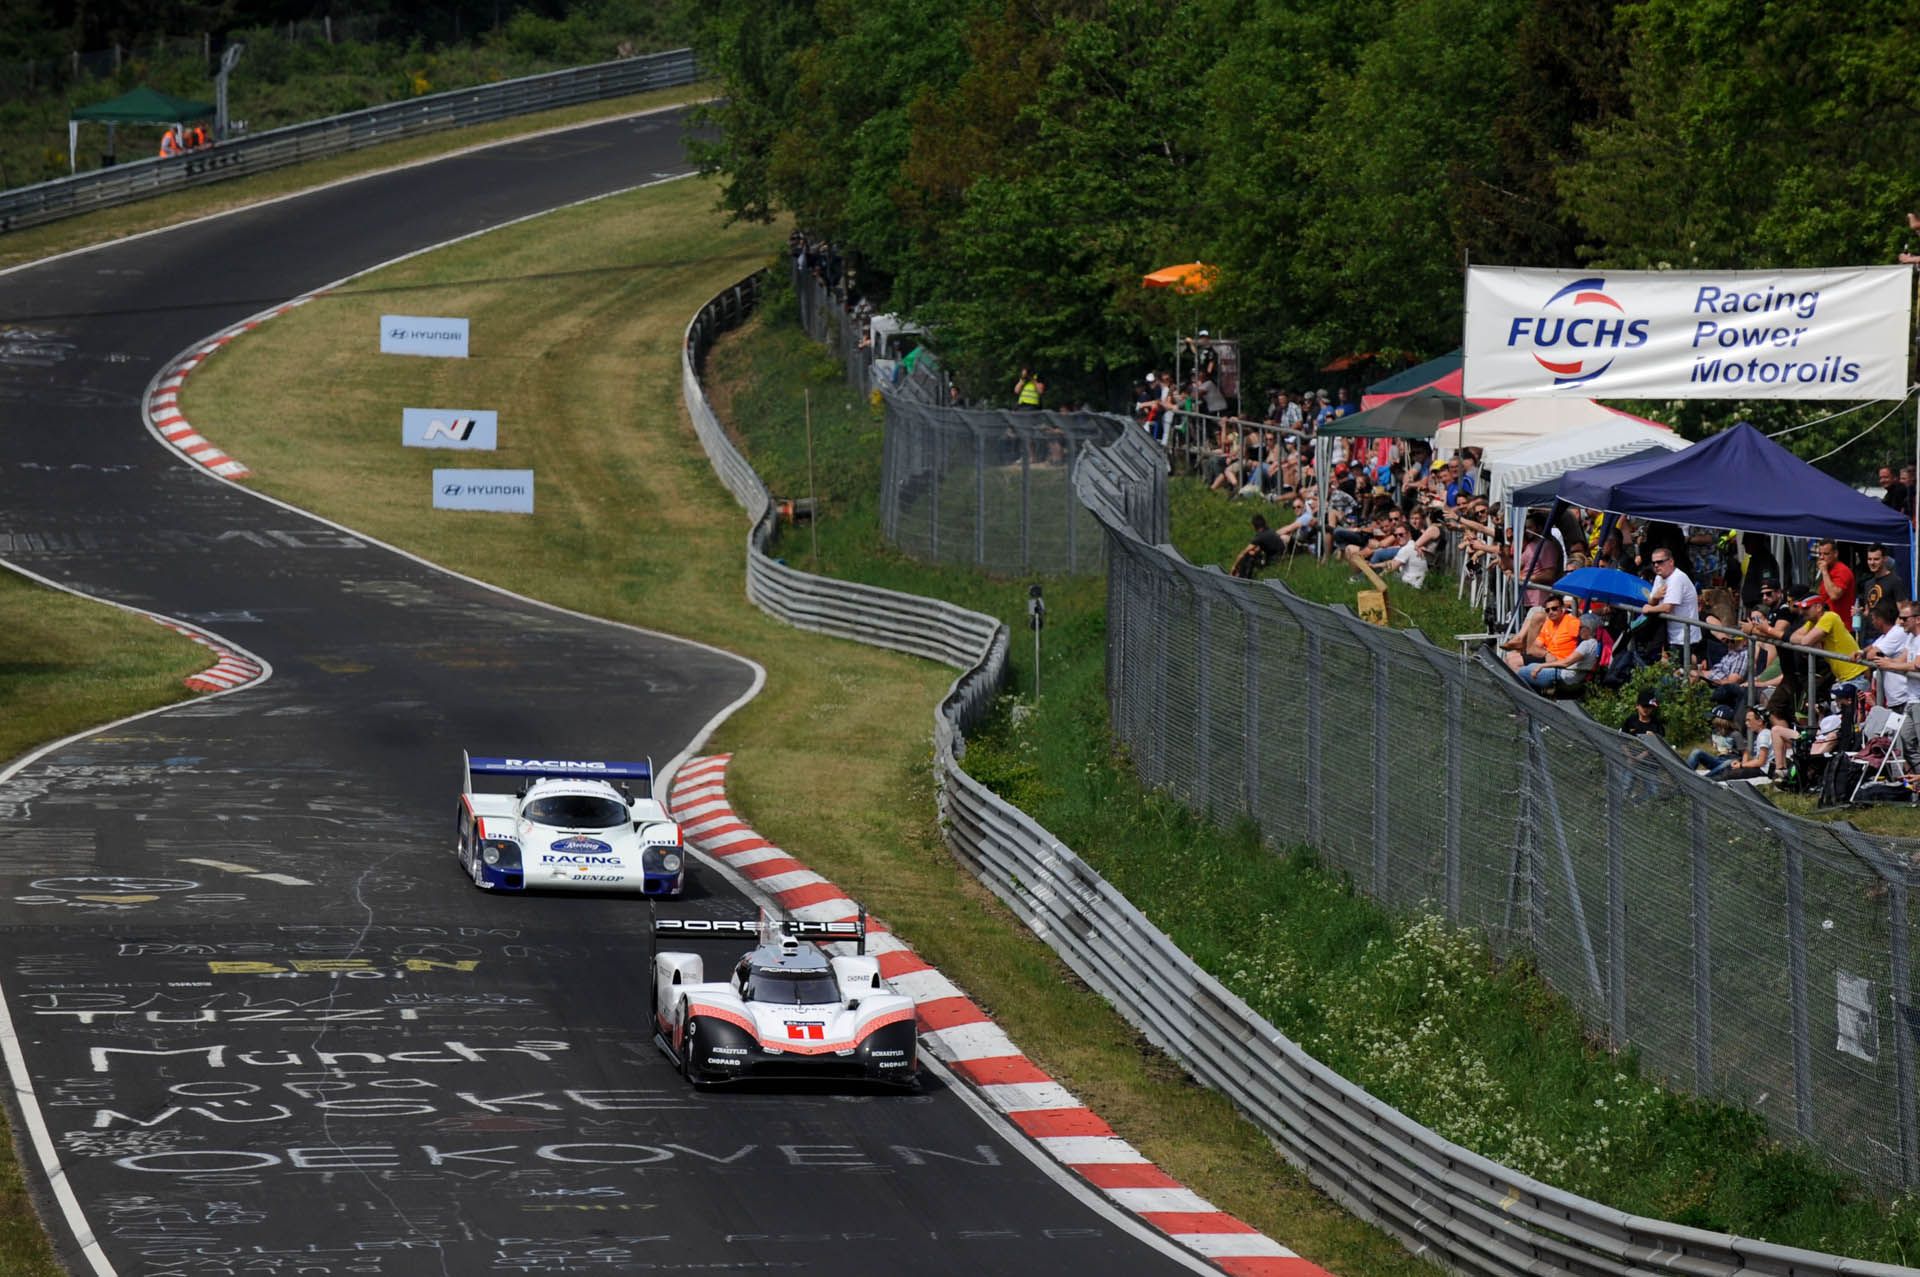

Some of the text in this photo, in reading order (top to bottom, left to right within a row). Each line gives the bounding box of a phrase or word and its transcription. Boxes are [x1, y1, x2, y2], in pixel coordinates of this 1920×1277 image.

[1694, 285, 1820, 319] Racing
[411, 331, 462, 340] HYUNDAI
[1507, 318, 1649, 349] FUCHS
[1692, 321, 1808, 348] Power
[1690, 355, 1860, 384] Motoroils
[467, 485, 525, 495] HYUNDAI
[505, 760, 606, 769] RACING
[542, 855, 621, 864] RACING
[571, 874, 625, 882] DUNLOP
[656, 920, 859, 932] PORSCHE
[207, 959, 481, 974] BEN
[20, 992, 352, 1008] BMW
[707, 1058, 741, 1066] CHOPARD
